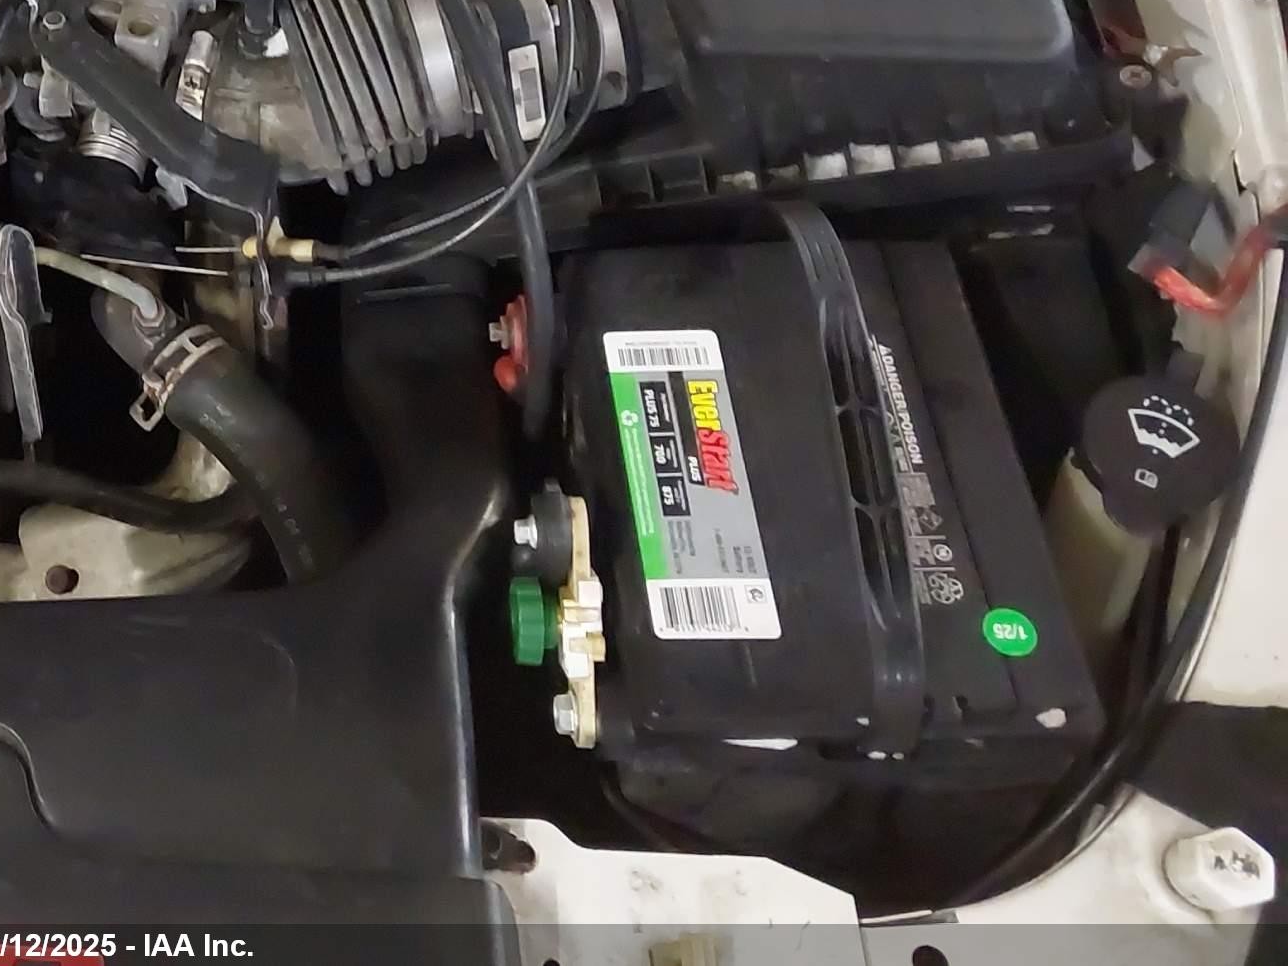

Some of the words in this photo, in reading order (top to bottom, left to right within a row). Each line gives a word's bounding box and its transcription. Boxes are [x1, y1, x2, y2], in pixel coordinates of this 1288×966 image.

[644, 388, 658, 413] PLUS
[650, 414, 660, 428] 75
[687, 380, 738, 493] EverStart
[654, 443, 667, 465] 700
[687, 455, 702, 483] PLUS
[992, 622, 1029, 640] 1/25
